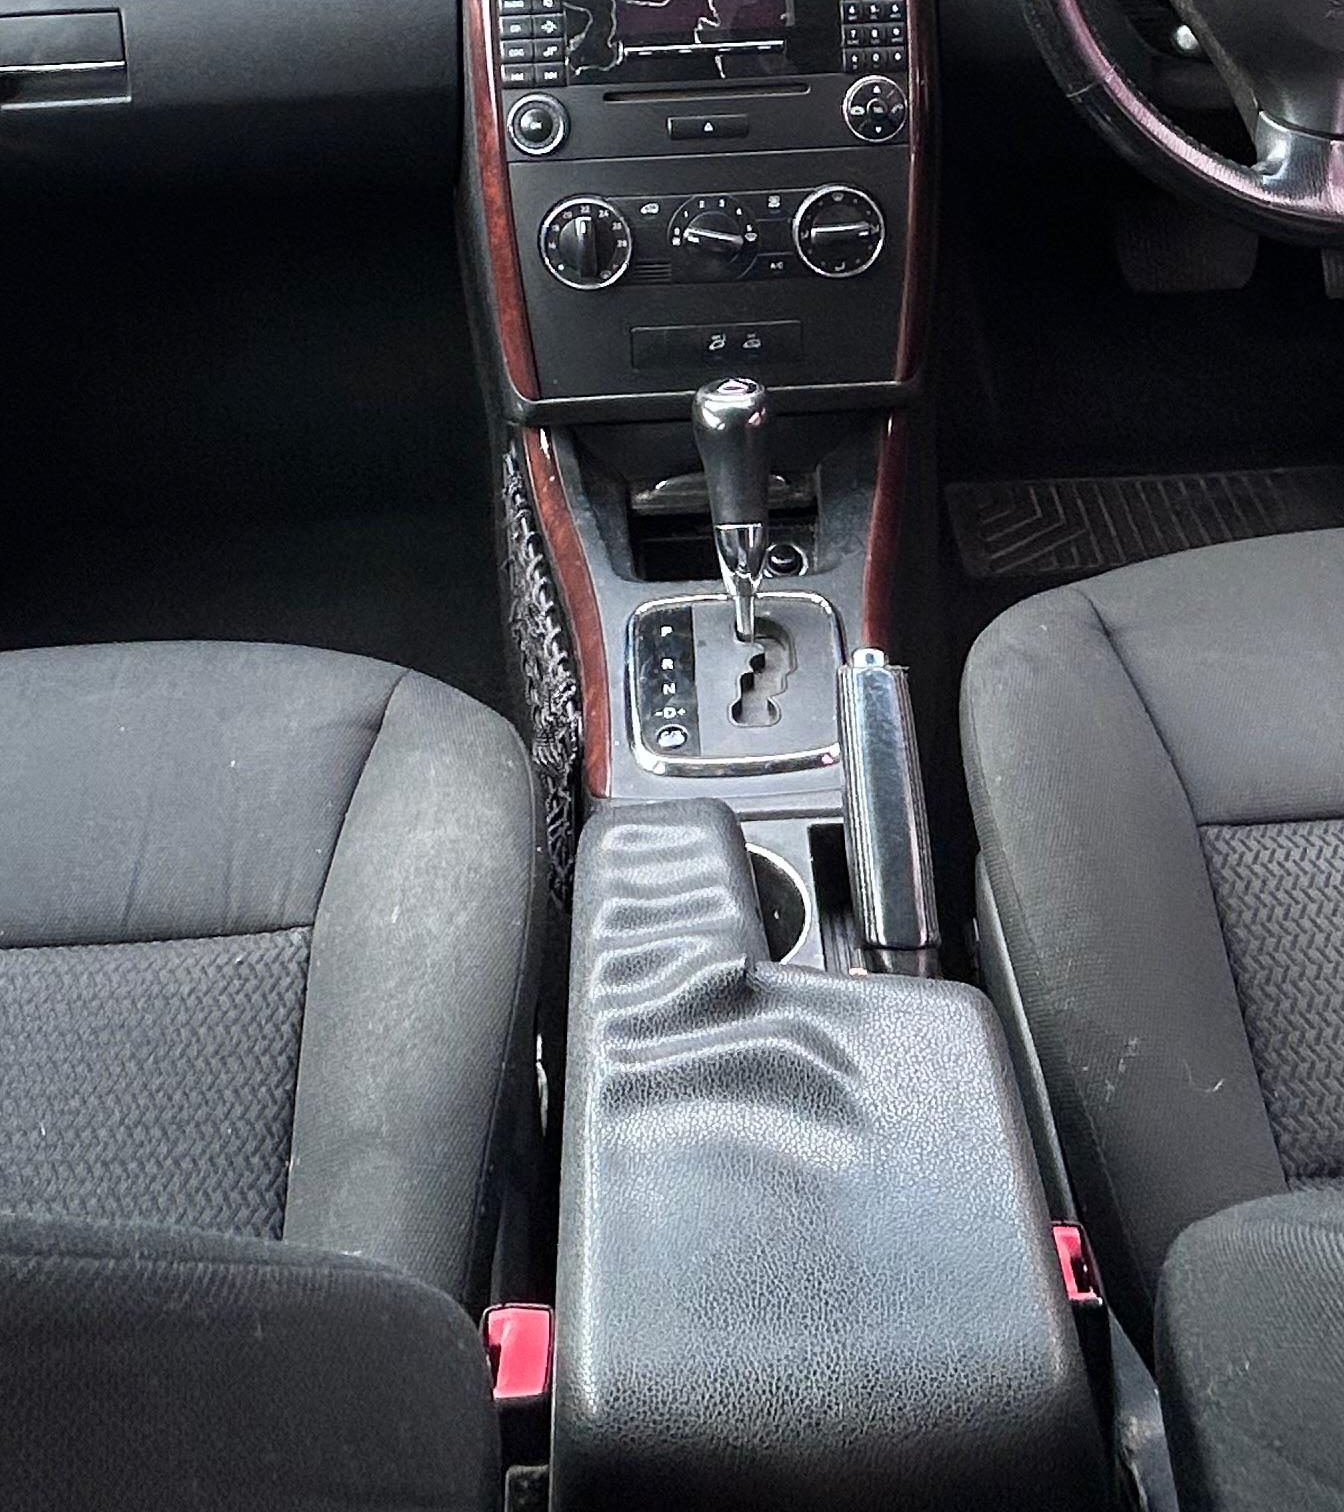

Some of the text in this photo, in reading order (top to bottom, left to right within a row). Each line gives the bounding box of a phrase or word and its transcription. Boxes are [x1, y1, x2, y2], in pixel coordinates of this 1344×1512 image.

[598, 209, 609, 219] 24
[660, 626, 673, 637] P
[661, 658, 674, 670] R
[662, 682, 676, 694] N
